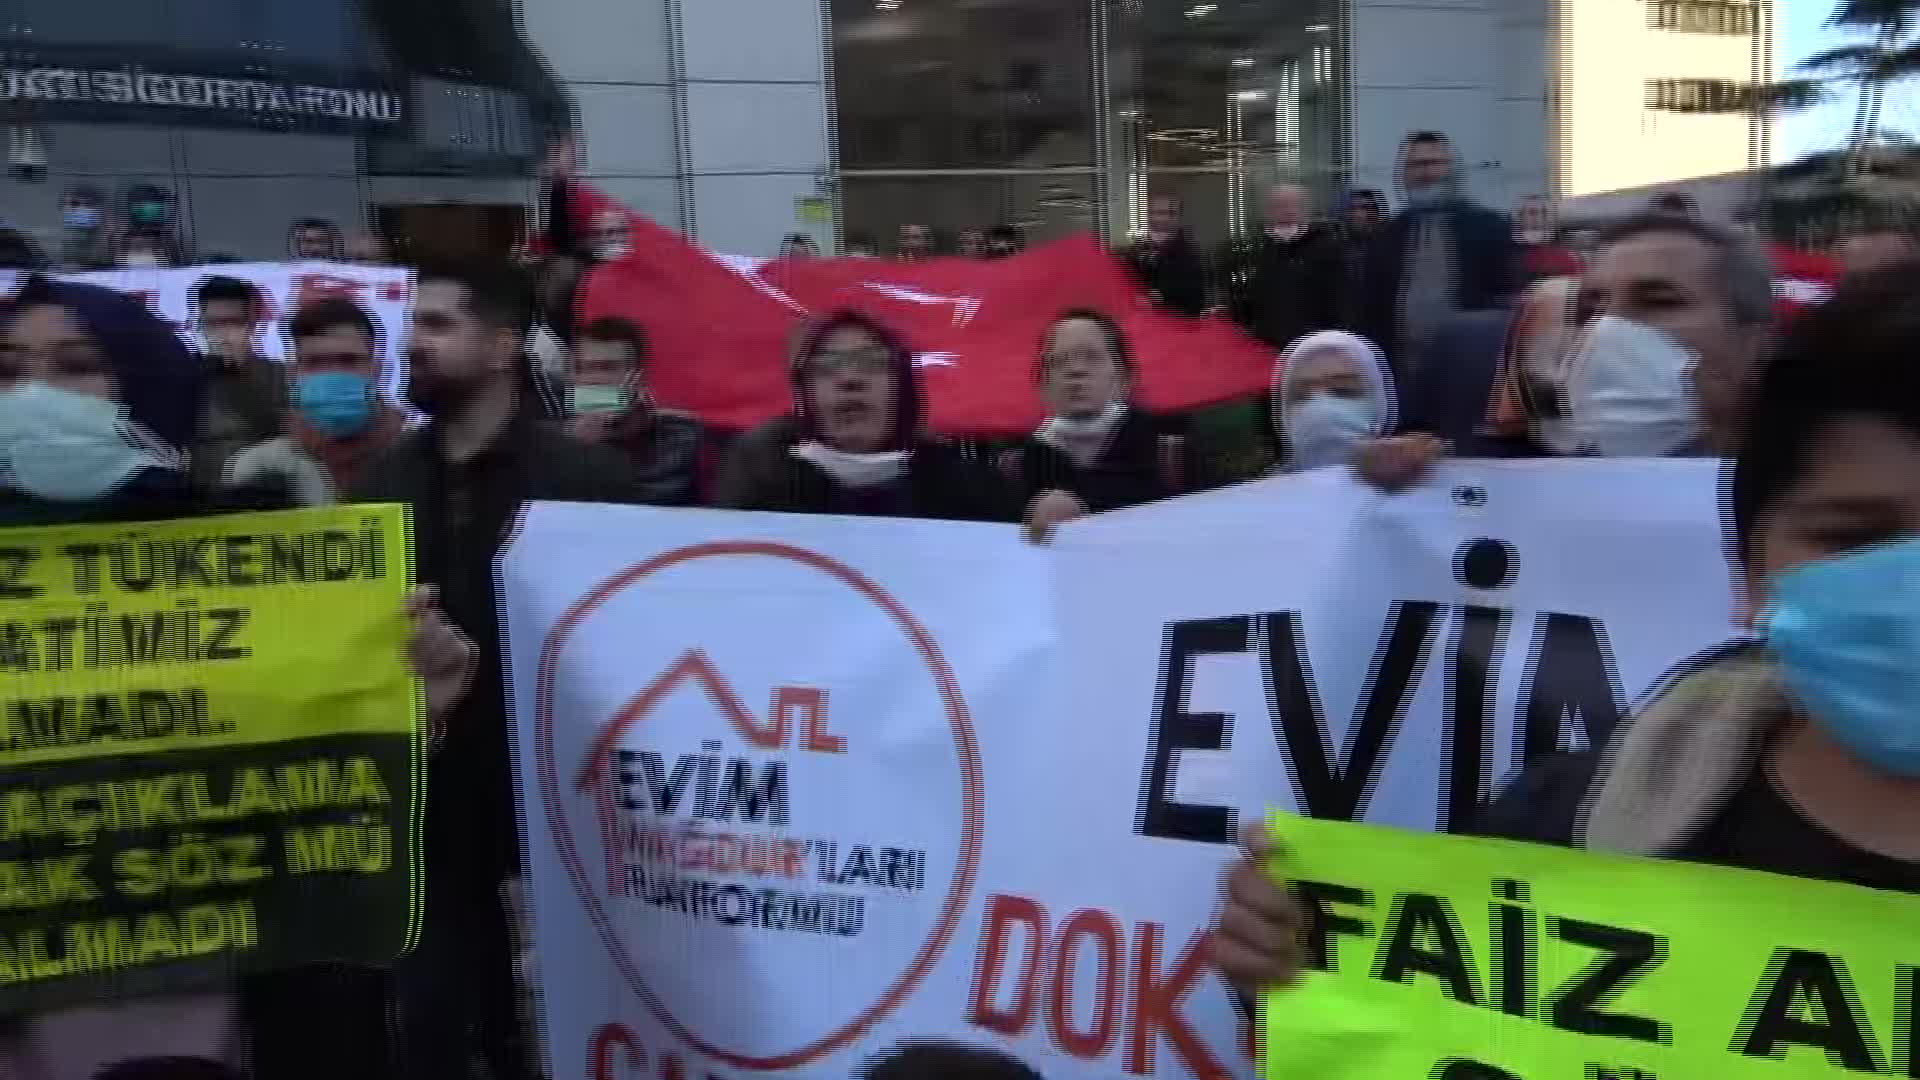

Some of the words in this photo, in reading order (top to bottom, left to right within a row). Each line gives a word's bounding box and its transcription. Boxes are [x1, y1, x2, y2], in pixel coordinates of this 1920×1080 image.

[92, 64, 294, 112] SİGORTA
[293, 85, 402, 121] FONU
[57, 514, 387, 597] TÜKENDİ
[0, 755, 392, 848] AÇIKLAMA
[610, 740, 790, 827] EVİM
[111, 832, 273, 898] SÖZ
[284, 813, 393, 876] MÜ
[623, 863, 866, 937] PLATFORMU
[963, 893, 1256, 1080] DOK
[1286, 877, 1674, 1047] FAİZ
